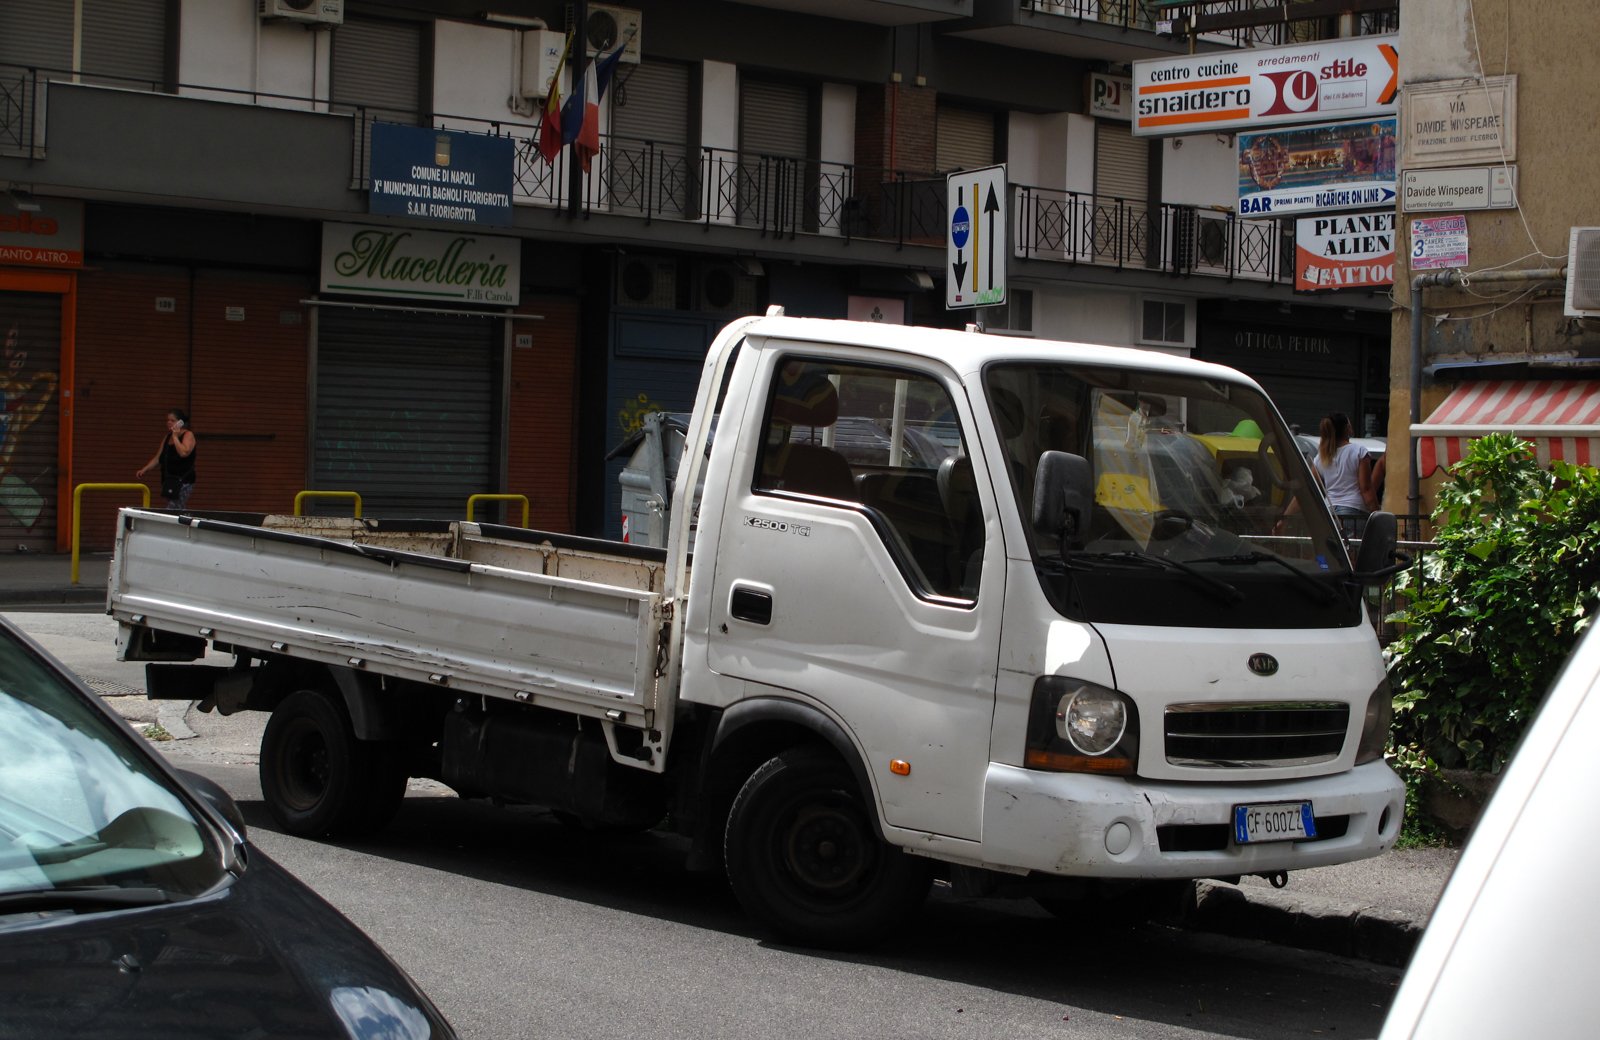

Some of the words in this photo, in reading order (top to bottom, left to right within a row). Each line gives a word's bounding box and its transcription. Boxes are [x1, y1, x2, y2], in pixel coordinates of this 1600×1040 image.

[1151, 66, 1190, 82] centro
[1197, 59, 1238, 78] cucine
[1258, 52, 1320, 67] arredamenti
[1320, 57, 1368, 81] stile
[1138, 89, 1251, 115] snaidero
[1449, 101, 1466, 114] VIA
[1416, 120, 1447, 134] DAVIDE
[411, 166, 441, 182] COMUNE
[442, 169, 450, 182] DI
[450, 170, 475, 186] NAPOLI
[383, 181, 431, 199] MUNICIPALITÀ
[432, 187, 462, 203] BAGNOLI
[463, 190, 510, 208] FUORIGROTTA
[1240, 196, 1272, 214] BAR
[1316, 191, 1350, 208] RICARICHE
[1352, 190, 1362, 204] ON
[1363, 188, 1379, 204] LINE
[1406, 186, 1436, 198] Davide
[1437, 185, 1484, 198] Winspeare
[407, 202, 428, 217] S.A.M.
[429, 204, 477, 222] FUORIGROTTA
[1315, 213, 1396, 236] PLANET
[1323, 234, 1391, 256] ALIEN
[1413, 239, 1425, 257] 3
[334, 229, 508, 288] Macelleria
[1235, 330, 1283, 350] OTTICA
[1288, 335, 1331, 354] PETRIK
[744, 516, 788, 533] K2500
[1247, 812, 1261, 834] CF
